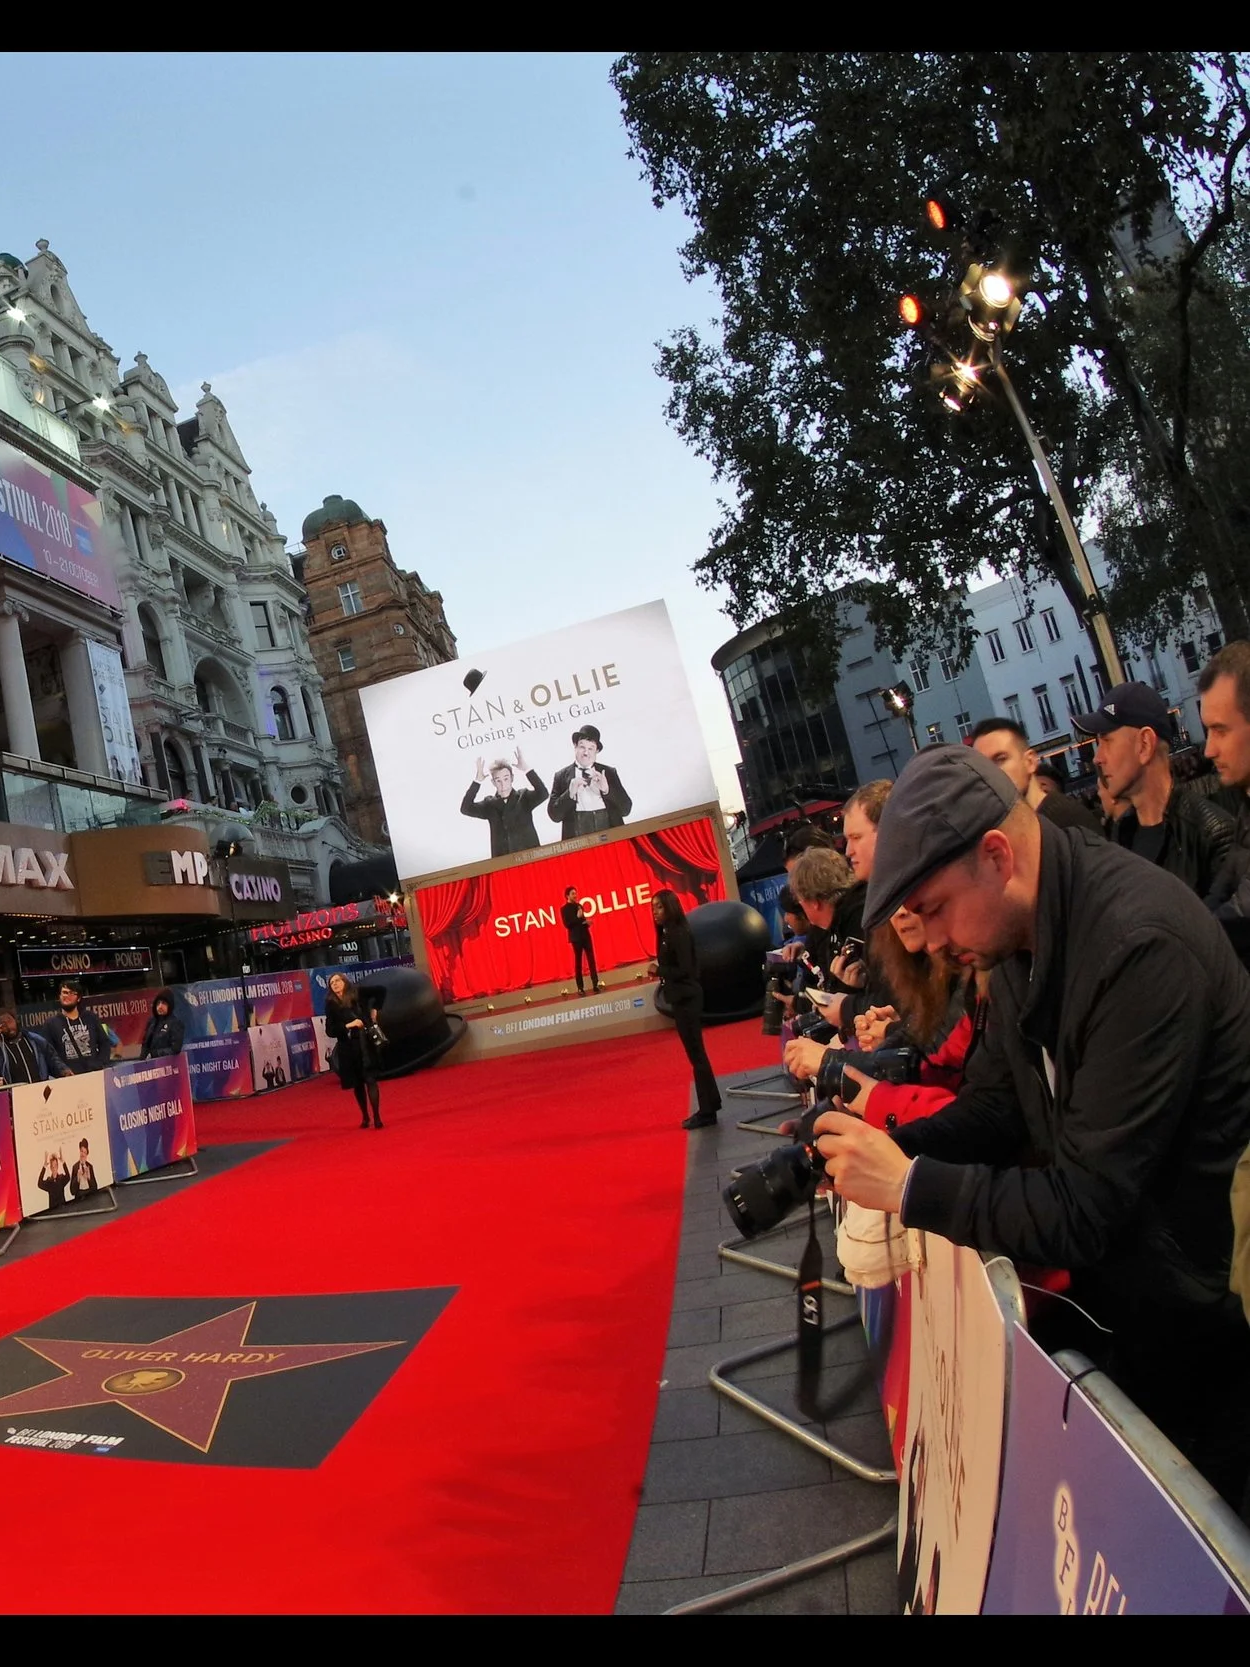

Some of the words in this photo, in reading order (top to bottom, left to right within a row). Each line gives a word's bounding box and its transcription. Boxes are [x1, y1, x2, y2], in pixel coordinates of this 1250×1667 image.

[41, 502, 73, 549] 2018
[431, 696, 506, 736] STAN
[513, 698, 525, 714] &
[530, 663, 622, 708] OLLIE
[456, 723, 516, 751] Closing
[520, 710, 565, 733] Night
[568, 698, 607, 719] Gala
[229, 872, 283, 903] CASINO
[495, 905, 557, 938] STAN
[579, 883, 653, 918] OLLIE
[280, 927, 333, 948] CASINO
[51, 953, 91, 970] CASINO
[114, 952, 143, 967] POKER
[210, 988, 236, 1004] LONDON
[257, 981, 282, 998] FESTIVAL
[130, 1000, 148, 1014] 2018
[505, 1022, 518, 1034] BFI
[518, 1014, 554, 1031] LONDON
[555, 1009, 580, 1024] FILM
[580, 1003, 613, 1019] FESTIVAL
[614, 999, 631, 1012] 2018
[202, 1060, 221, 1072] NIGHT
[222, 1058, 239, 1070] GALA
[33, 1116, 59, 1136] STAN
[66, 1107, 93, 1127] OLLIE
[119, 1108, 148, 1132] CLOSING
[147, 1102, 167, 1123] NIGHT
[166, 1098, 183, 1118] GALA
[80, 1347, 178, 1364] OLIVER
[181, 1350, 285, 1365] HARDY
[4, 1435, 53, 1447] FESTIVAL
[35, 1430, 88, 1443] LONDON
[83, 1435, 125, 1446] FILM
